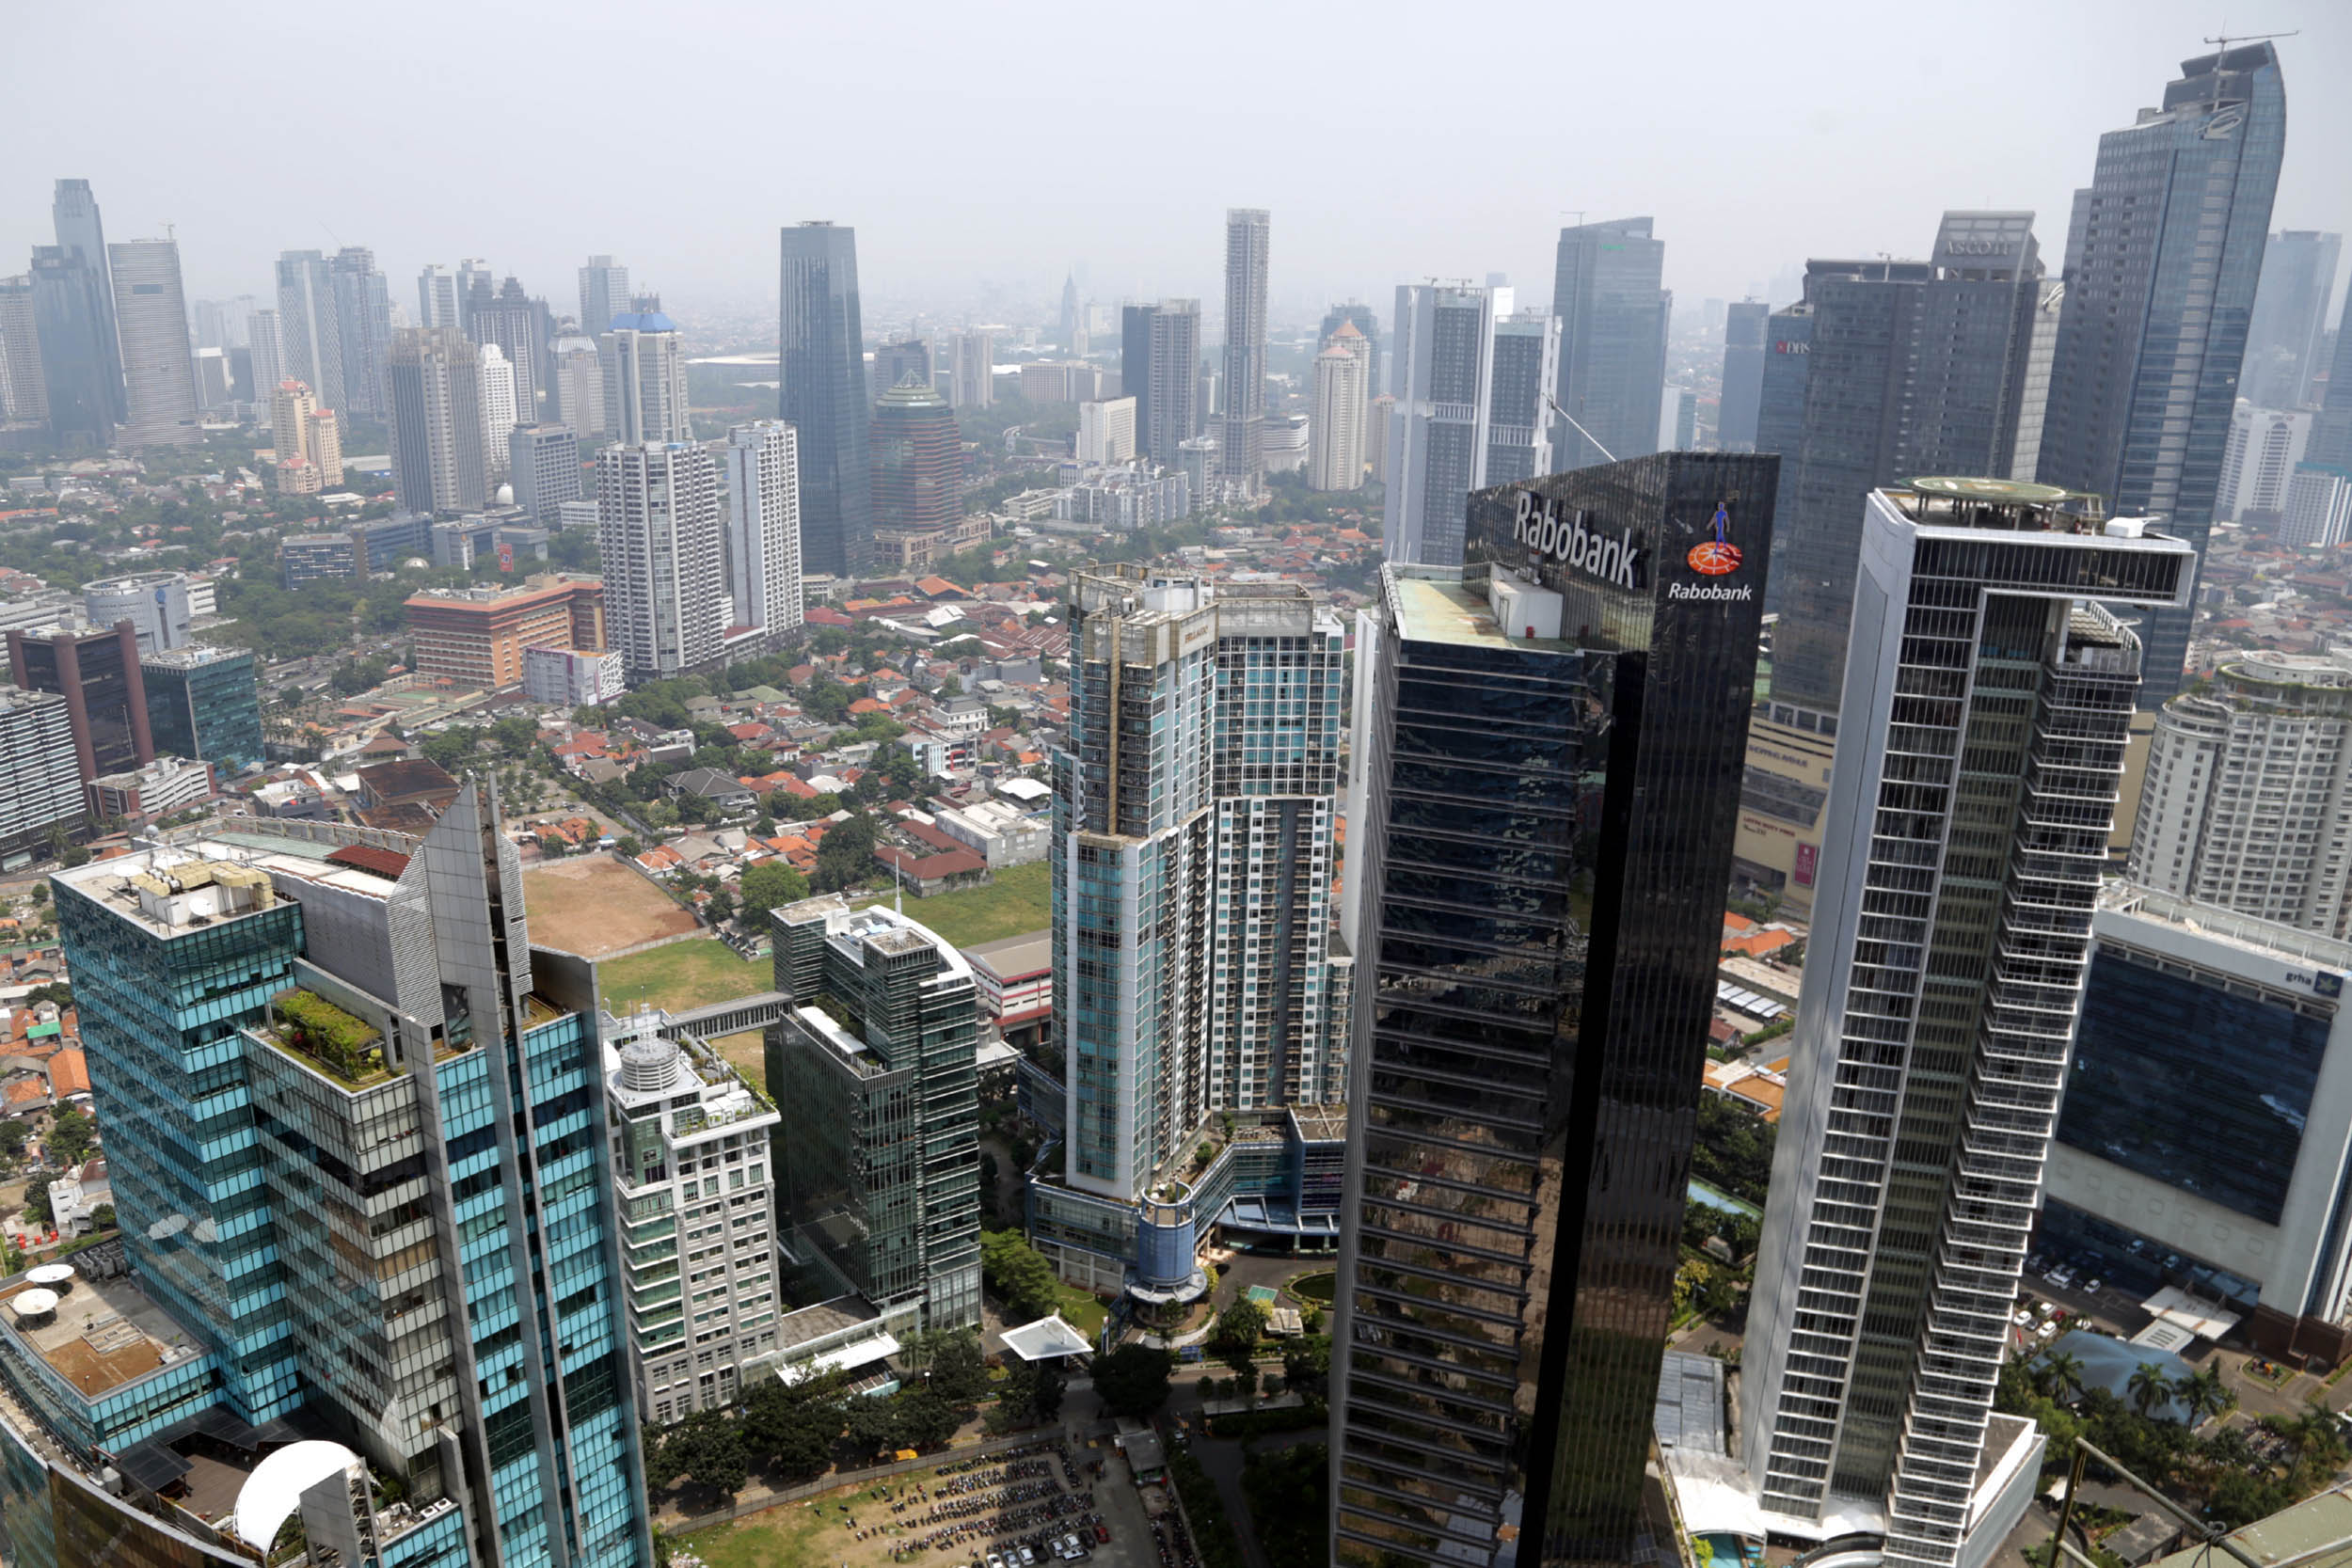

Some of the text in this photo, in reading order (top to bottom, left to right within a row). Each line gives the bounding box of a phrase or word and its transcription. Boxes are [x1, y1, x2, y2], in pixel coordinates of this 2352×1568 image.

[1514, 488, 1639, 589] Rabobank
[1668, 582, 1753, 601] Rabobank
[2286, 972, 2312, 986] grha
